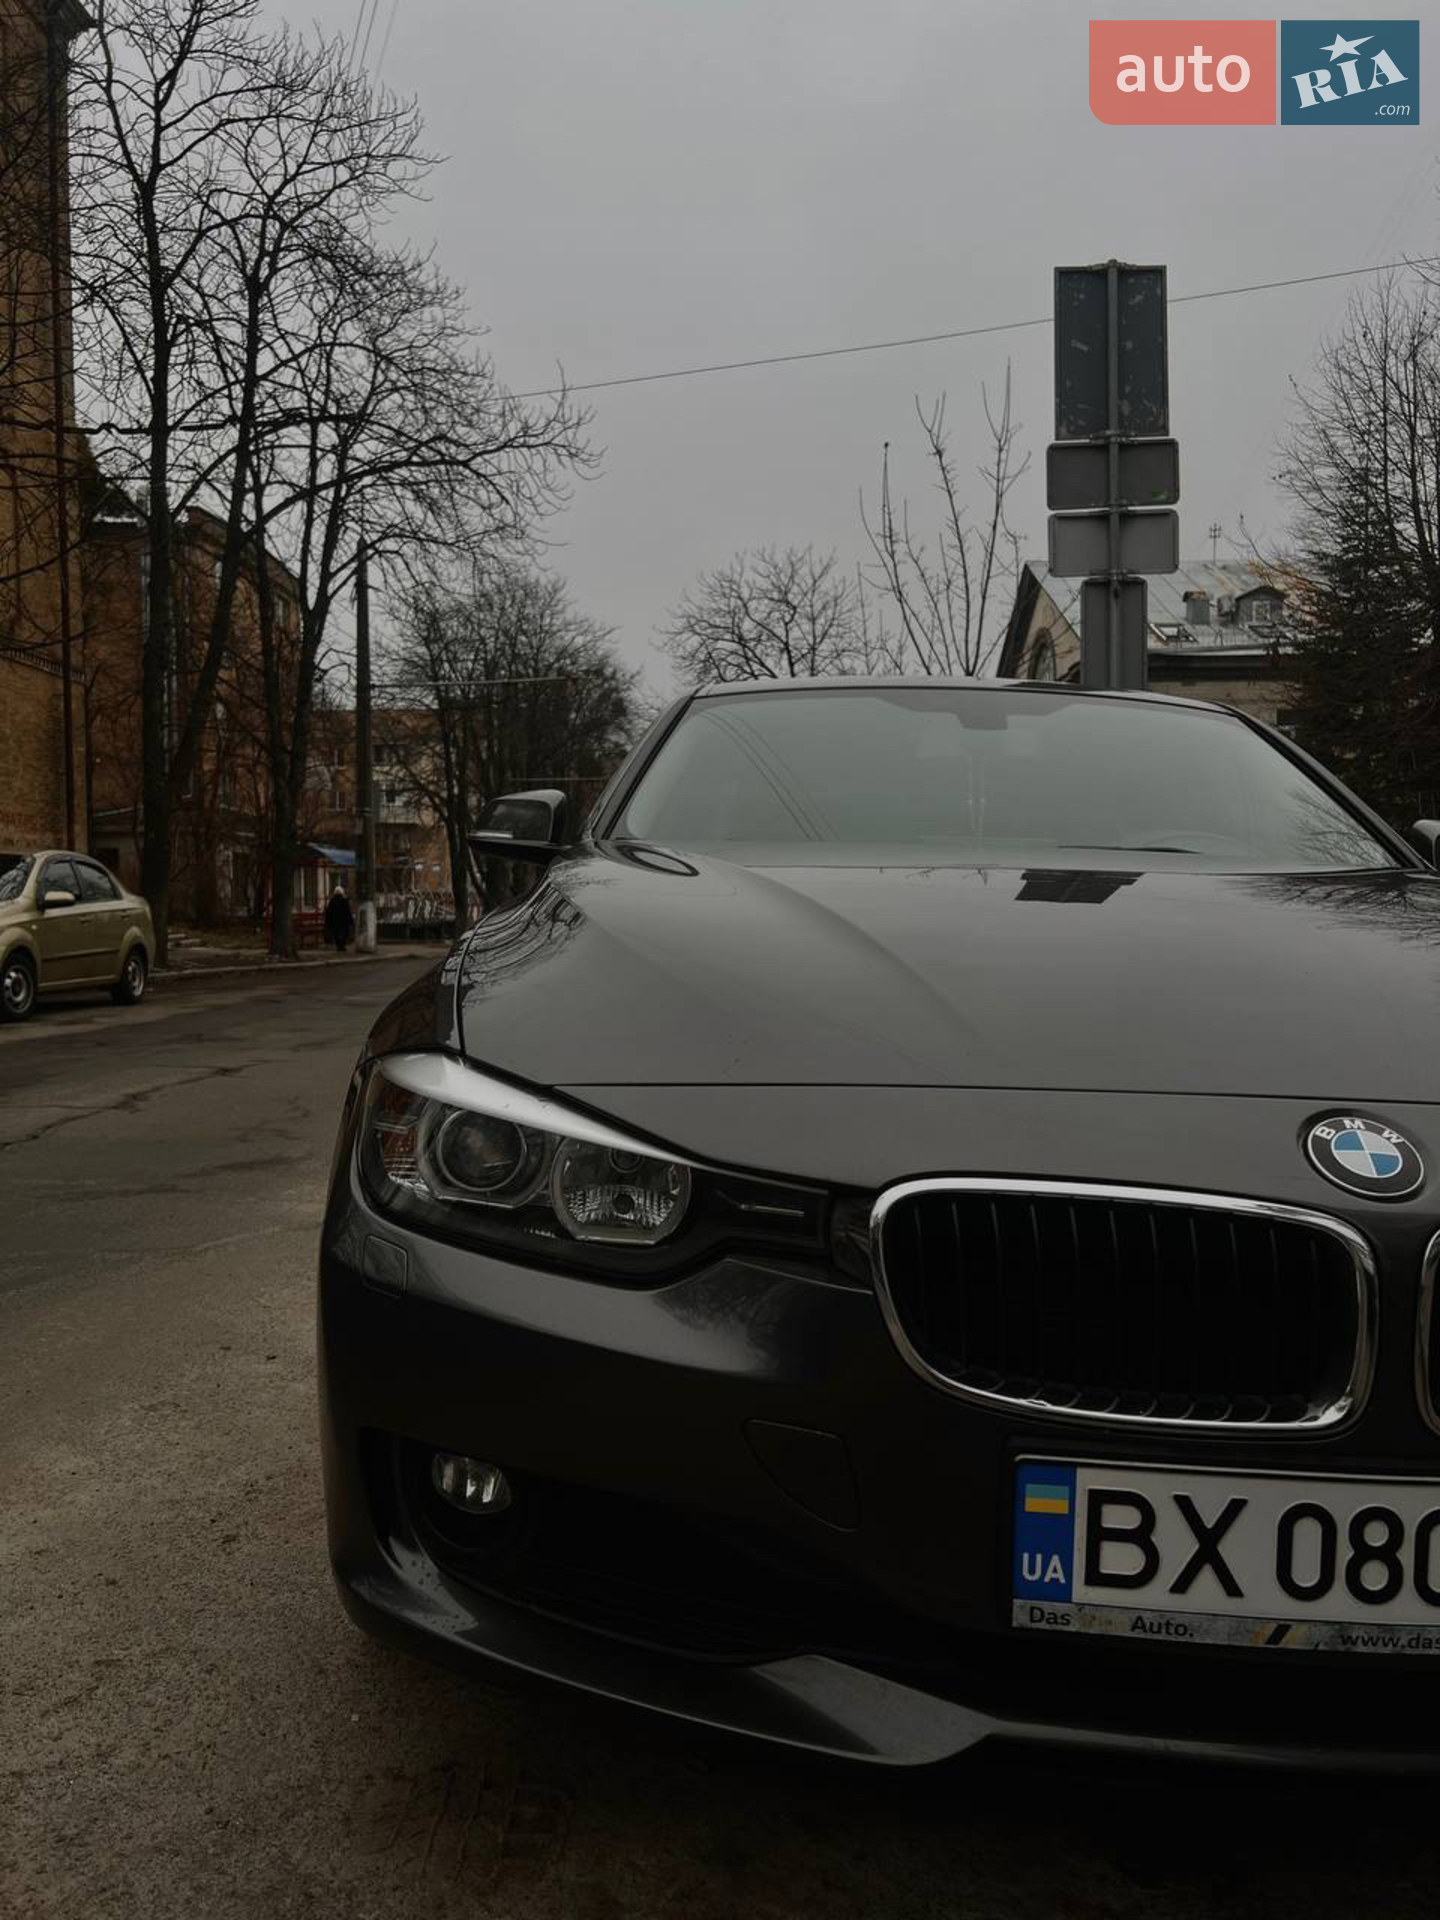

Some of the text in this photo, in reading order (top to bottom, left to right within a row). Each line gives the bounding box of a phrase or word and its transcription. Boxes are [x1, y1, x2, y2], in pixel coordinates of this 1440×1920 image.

[1315, 1119, 1404, 1144] BMW
[1084, 1488, 1249, 1598] BX
[1022, 1553, 1066, 1584] UA
[1029, 1606, 1071, 1626] Das
